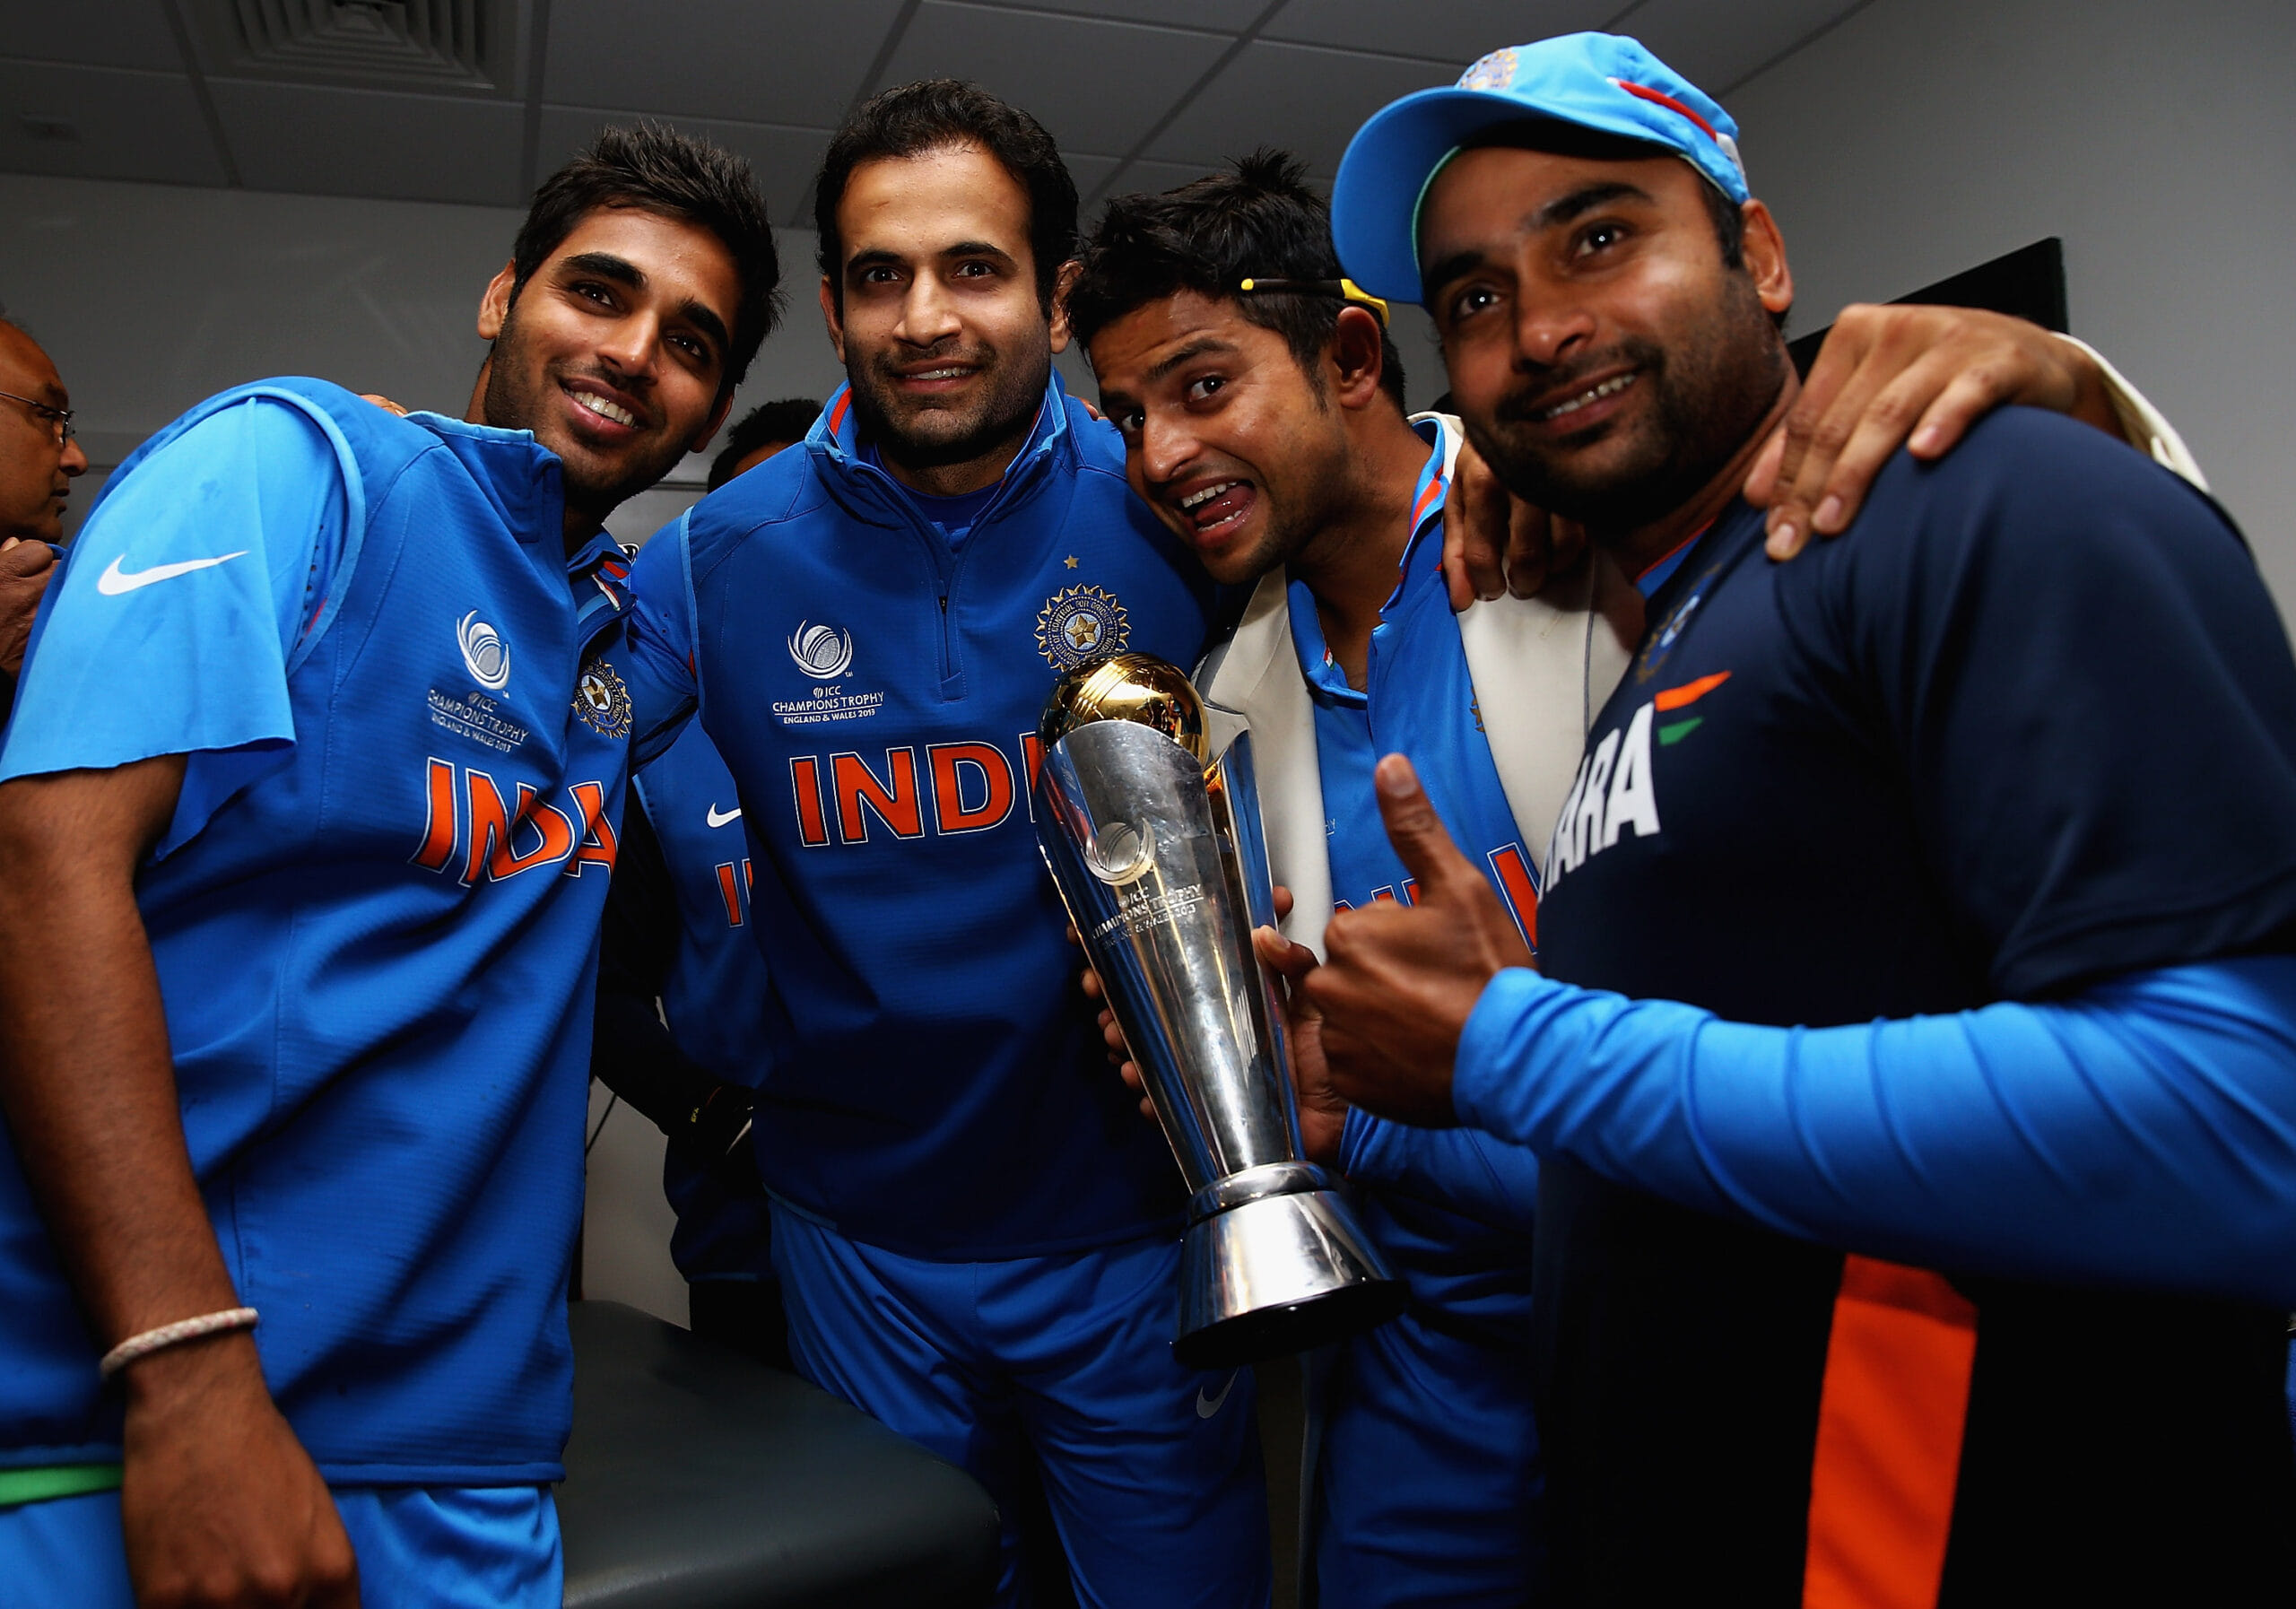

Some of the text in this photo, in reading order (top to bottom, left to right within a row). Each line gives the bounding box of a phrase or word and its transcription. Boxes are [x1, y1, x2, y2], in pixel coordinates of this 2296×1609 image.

[1051, 603, 1074, 632] CONTROL
[824, 685, 841, 697] ICC
[476, 696, 498, 713] ICC
[772, 691, 884, 712] CHAMPIONS TROPHY
[428, 689, 529, 743] CHAMPIONS TROPHY
[783, 709, 875, 725] ENGLAND & WALES 2013
[495, 740, 512, 753] 2013
